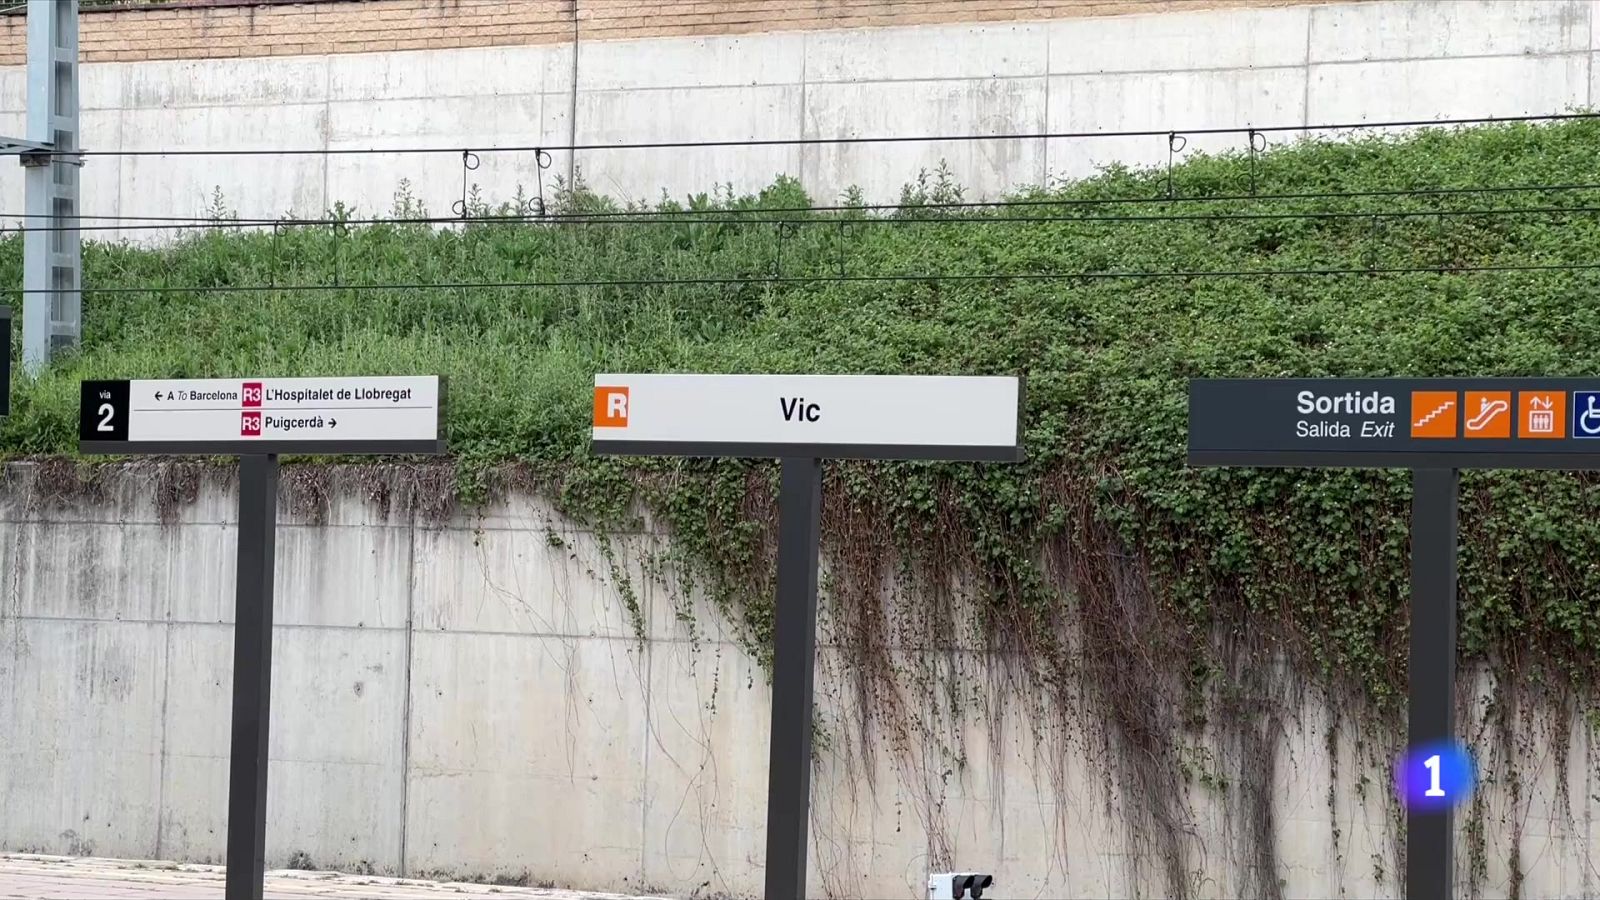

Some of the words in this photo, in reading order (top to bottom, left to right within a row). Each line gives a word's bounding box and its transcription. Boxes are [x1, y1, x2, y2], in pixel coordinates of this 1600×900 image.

[99, 390, 111, 399] via
[167, 391, 175, 401] A
[178, 391, 188, 401] To
[189, 390, 238, 401] Barcelona
[244, 388, 261, 402] R3
[266, 388, 334, 403] L'Hospitalet
[336, 388, 351, 400] de
[354, 388, 412, 402] Llobregat
[1296, 391, 1396, 414] Sortida
[97, 403, 114, 431] 2
[780, 397, 821, 422] Vic
[242, 417, 260, 431] R3
[265, 415, 324, 431] Puigcerdà
[1296, 420, 1351, 437] Salida
[1360, 421, 1396, 437] Exit
